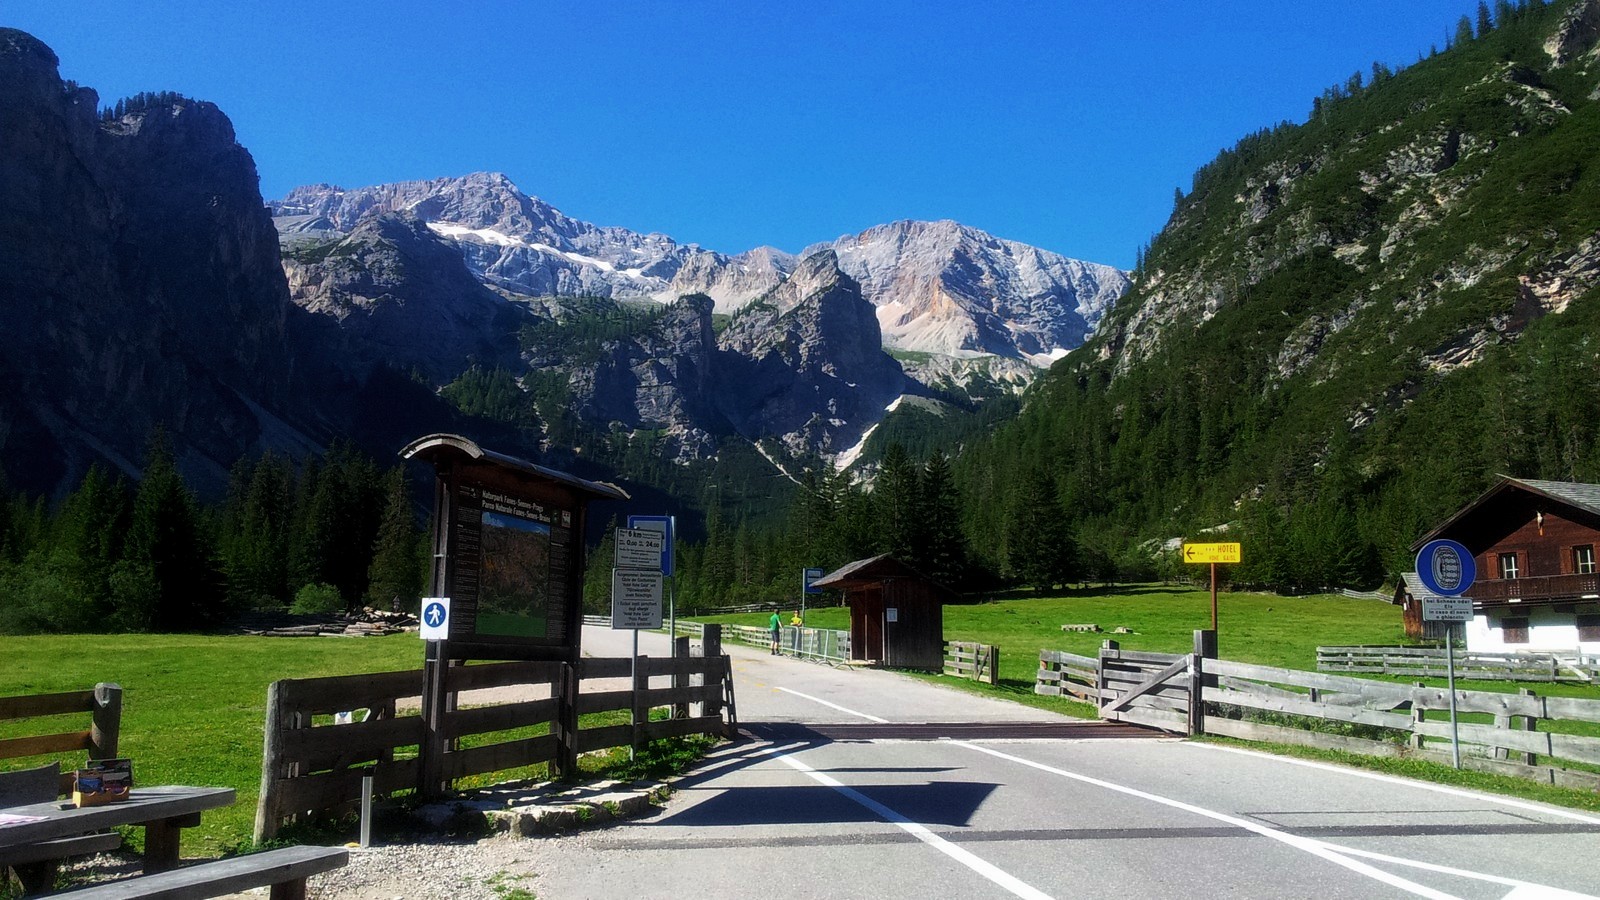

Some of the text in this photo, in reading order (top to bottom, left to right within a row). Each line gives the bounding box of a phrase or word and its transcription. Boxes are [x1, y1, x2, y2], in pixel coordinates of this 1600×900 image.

[482, 489, 503, 503] Naturpark
[481, 499, 495, 510] Parco
[495, 502, 513, 515] Naturale
[1218, 545, 1236, 553] HOTEL
